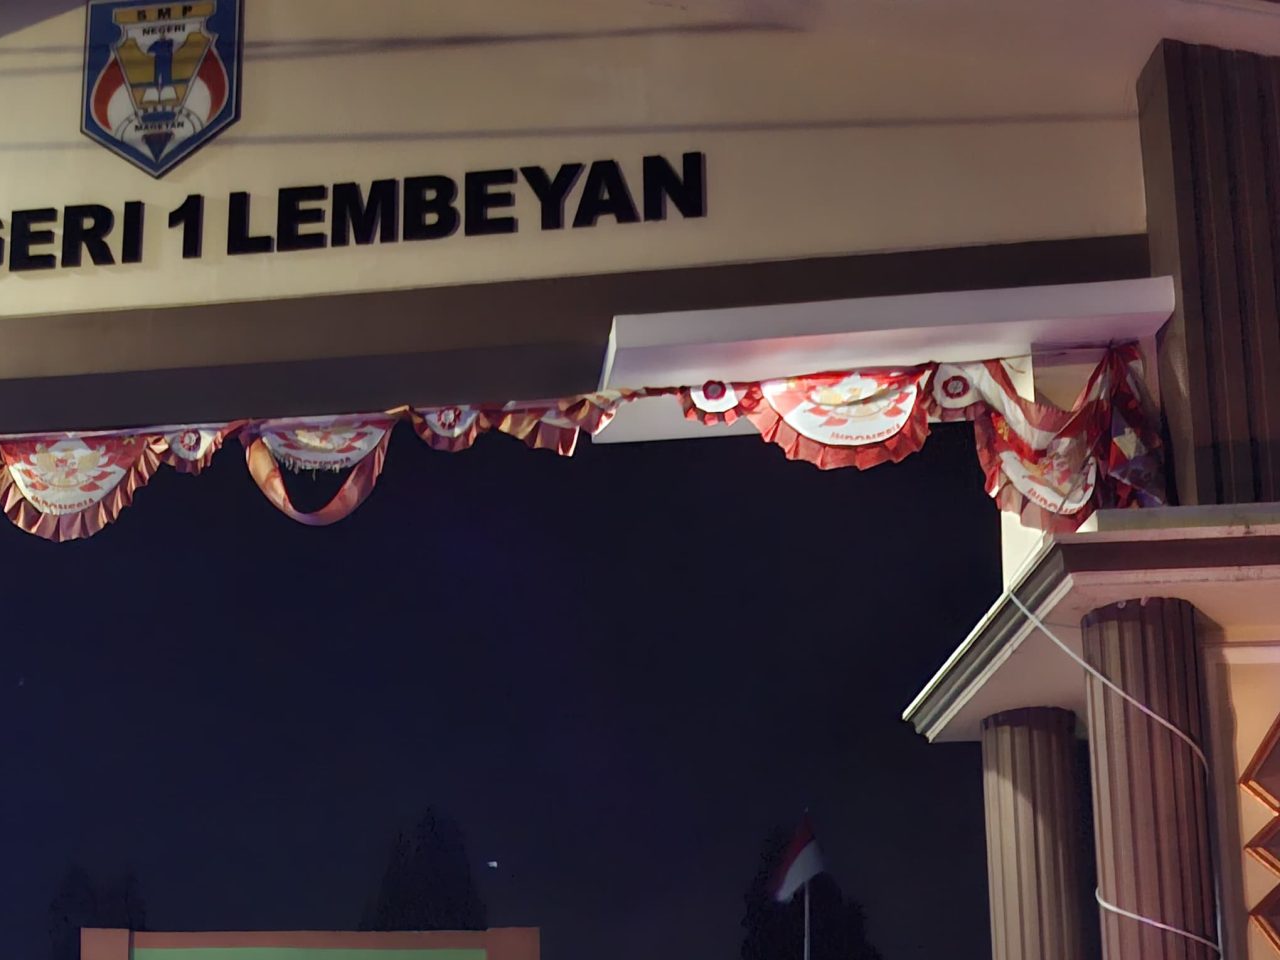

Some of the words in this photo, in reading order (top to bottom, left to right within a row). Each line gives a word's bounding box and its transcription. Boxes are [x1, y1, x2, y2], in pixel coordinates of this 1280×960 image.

[136, 5, 193, 20] SMP
[142, 25, 186, 36] NEGERI
[168, 193, 205, 259] 1
[226, 150, 708, 256] LEMBEYAN
